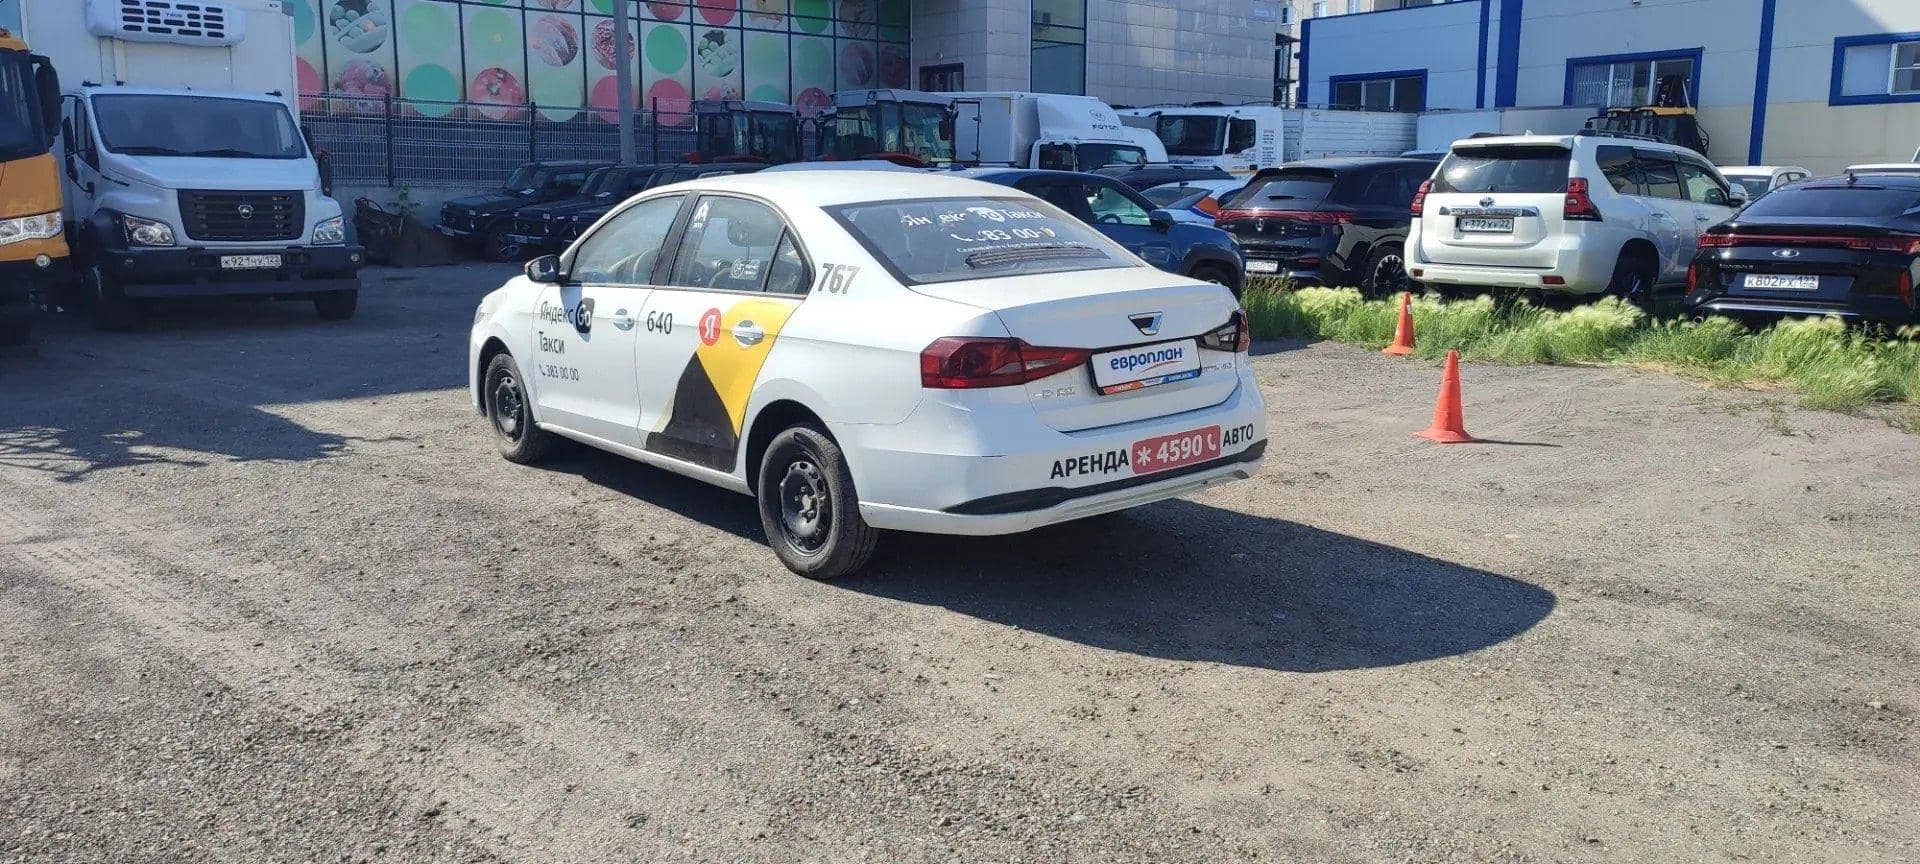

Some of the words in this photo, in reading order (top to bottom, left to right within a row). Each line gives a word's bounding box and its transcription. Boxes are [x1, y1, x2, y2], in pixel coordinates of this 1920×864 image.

[817, 262, 860, 295] 767
[541, 301, 574, 325] Яндекс
[647, 311, 673, 335] 640
[704, 314, 717, 340] Я
[538, 331, 565, 354] Такси
[1110, 347, 1183, 371] европлан
[1050, 448, 1130, 480] АРЕНДА
[1222, 423, 1255, 448] АВТО
